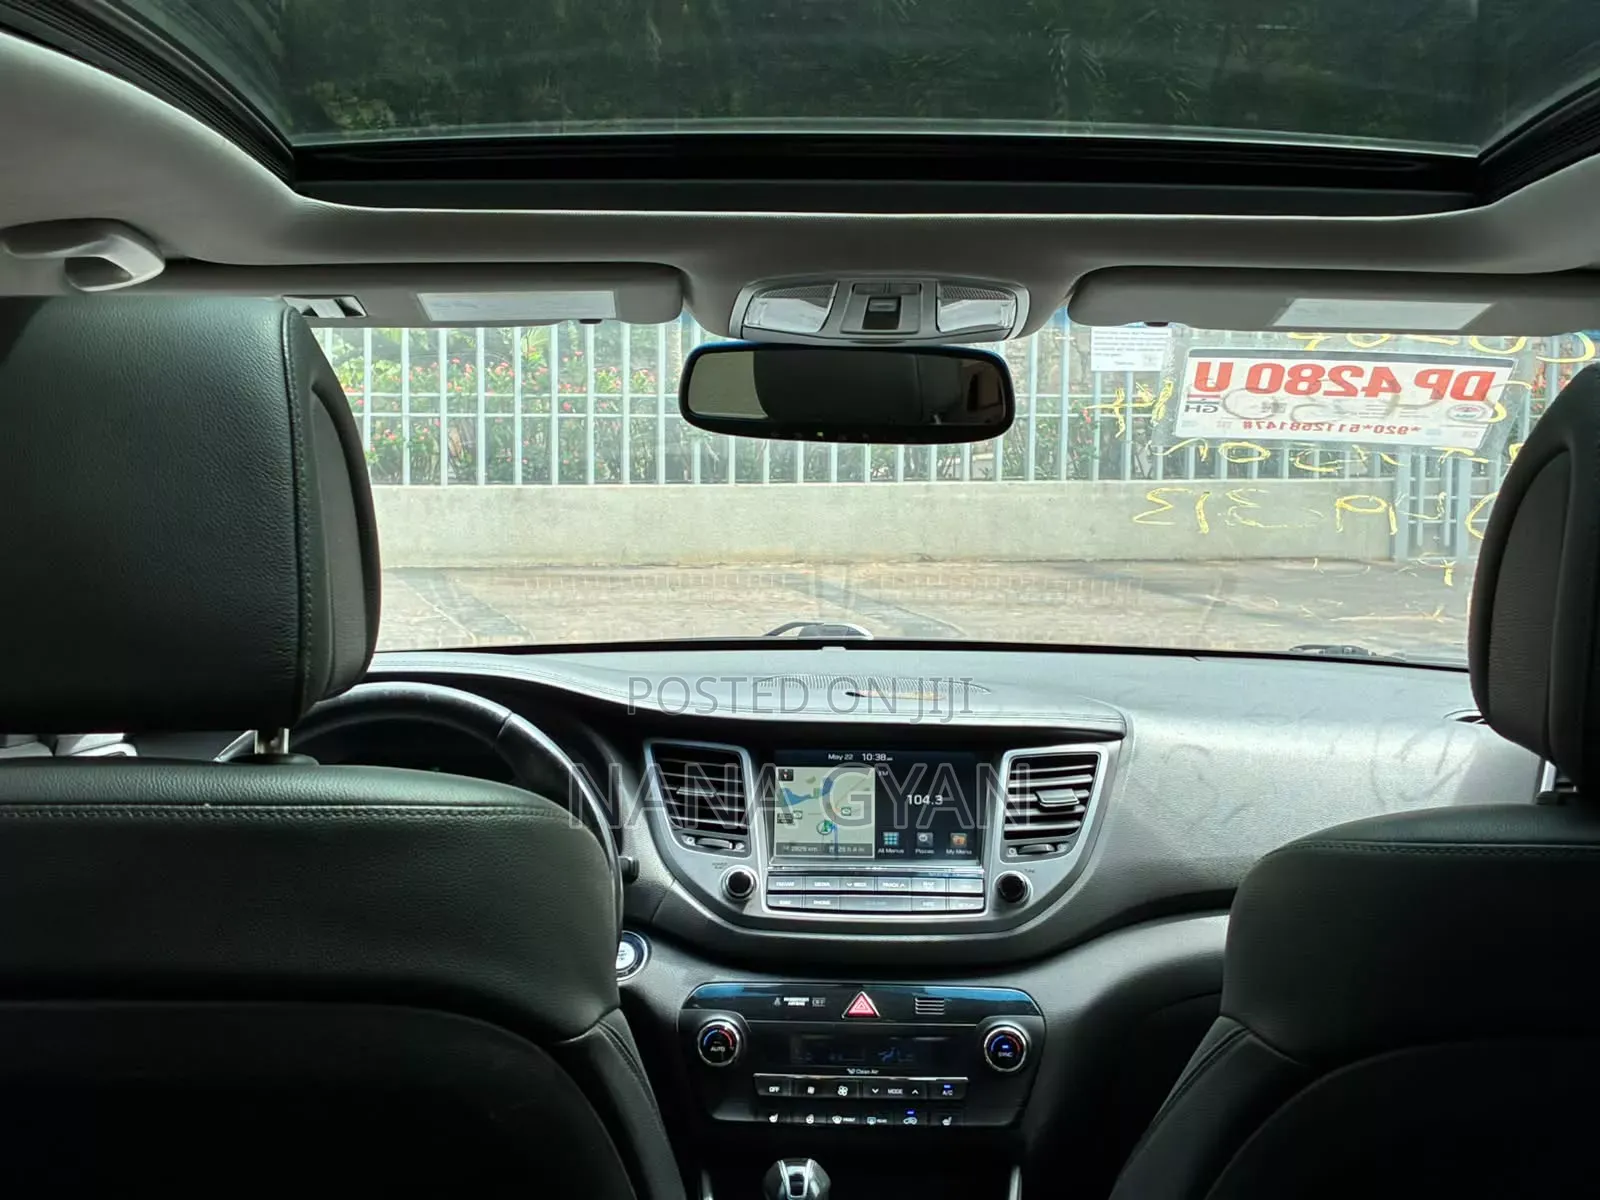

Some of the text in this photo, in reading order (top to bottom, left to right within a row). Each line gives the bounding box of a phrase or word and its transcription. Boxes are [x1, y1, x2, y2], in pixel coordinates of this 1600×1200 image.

[827, 753, 843, 761] May
[861, 752, 887, 761] 10:38
[906, 794, 944, 805] 104.3
